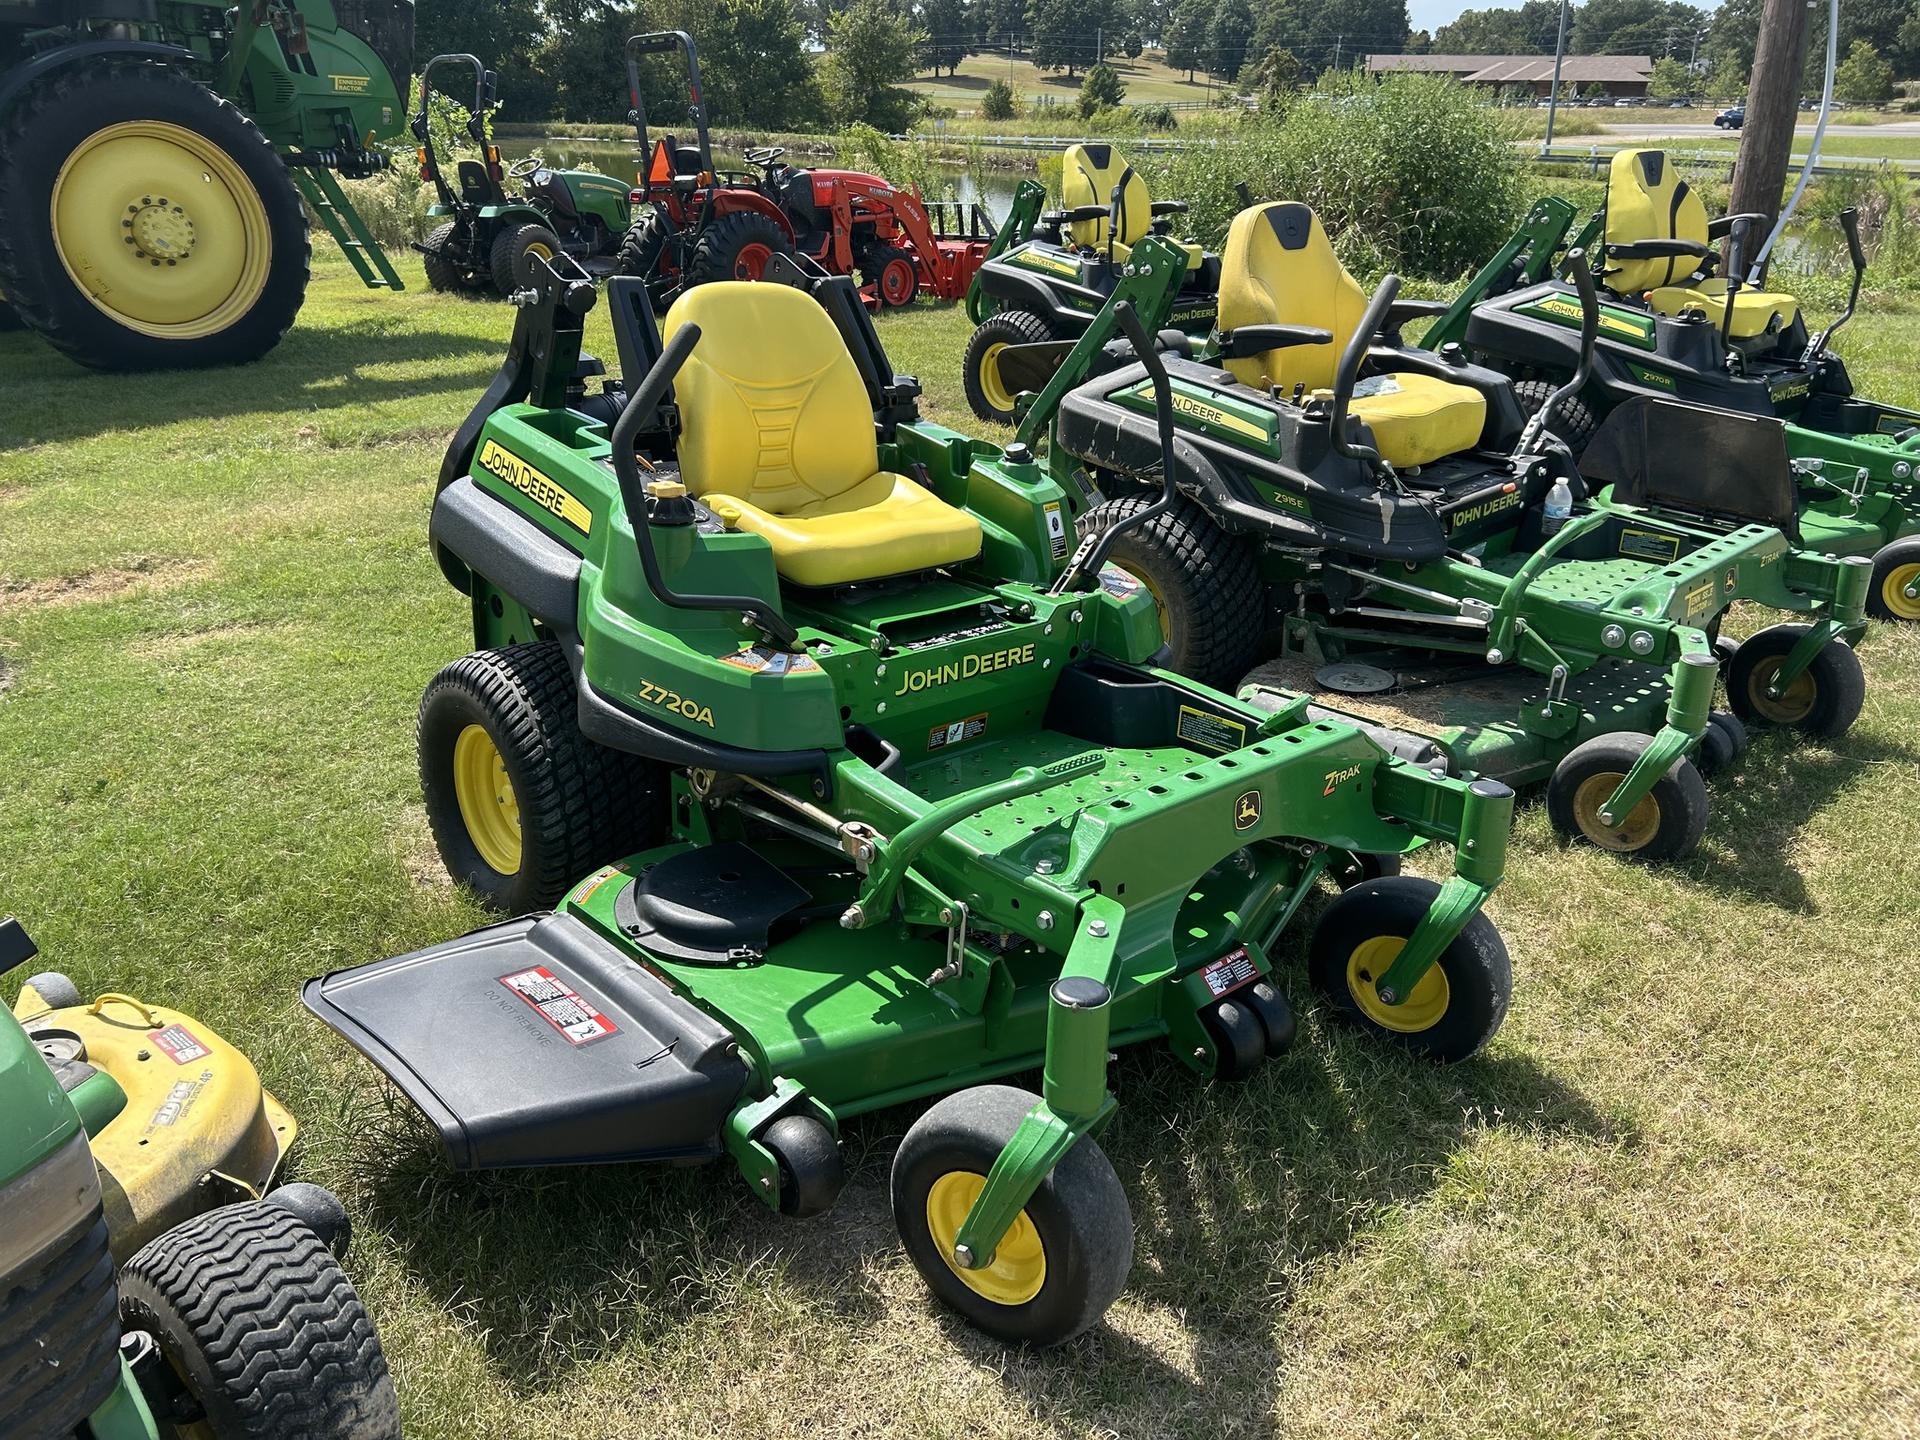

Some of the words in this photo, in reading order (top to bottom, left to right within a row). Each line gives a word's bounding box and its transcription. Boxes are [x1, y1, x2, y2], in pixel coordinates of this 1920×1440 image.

[869, 187, 893, 198] KUBOTA
[1168, 312, 1190, 323] JOHN
[1191, 309, 1216, 319] DEERE
[1548, 303, 1575, 316] JOHN
[1577, 310, 1609, 325] DRE
[1787, 383, 1809, 399] DEERE
[1183, 400, 1223, 423] DEERE
[486, 447, 519, 483] JOHN
[520, 466, 566, 513] DEERE
[1273, 491, 1304, 509] Z915E
[1483, 490, 1521, 517] DEERE
[895, 662, 959, 696] JOHN
[963, 643, 1035, 679] DEERE
[638, 678, 715, 729] Z720A
[484, 990, 500, 1001] DO
[498, 1000, 518, 1016] NOT
[517, 1014, 553, 1048] REMOVE
